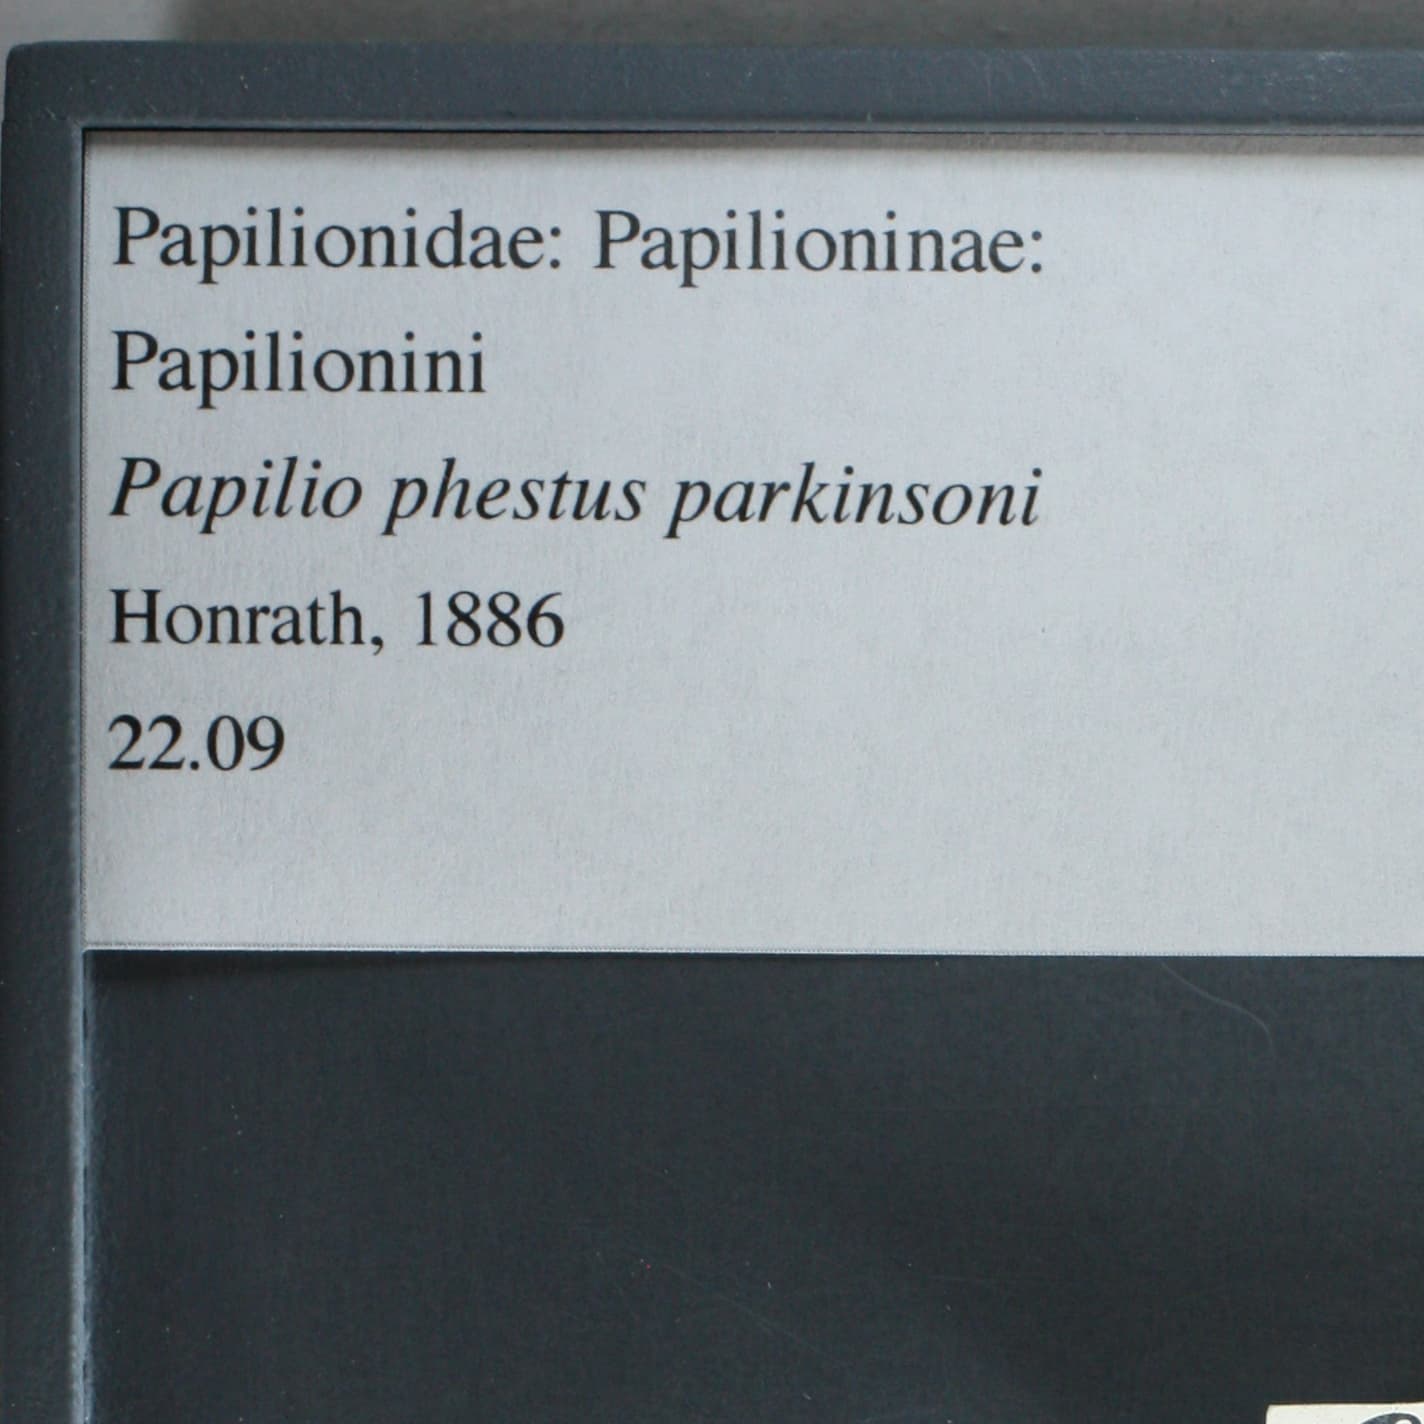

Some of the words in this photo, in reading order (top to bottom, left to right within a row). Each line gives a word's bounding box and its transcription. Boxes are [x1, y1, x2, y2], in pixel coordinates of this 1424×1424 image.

[113, 206, 561, 285] Papilionidae:
[594, 209, 1042, 288] Papilioninae:
[111, 329, 485, 410] Papilionini
[109, 455, 363, 535] Papilio
[381, 457, 646, 536] phestus
[664, 461, 1042, 540] parkinsoni
[110, 588, 384, 655] Honrath,
[418, 590, 564, 648] 1886
[108, 714, 285, 772] 22.09
